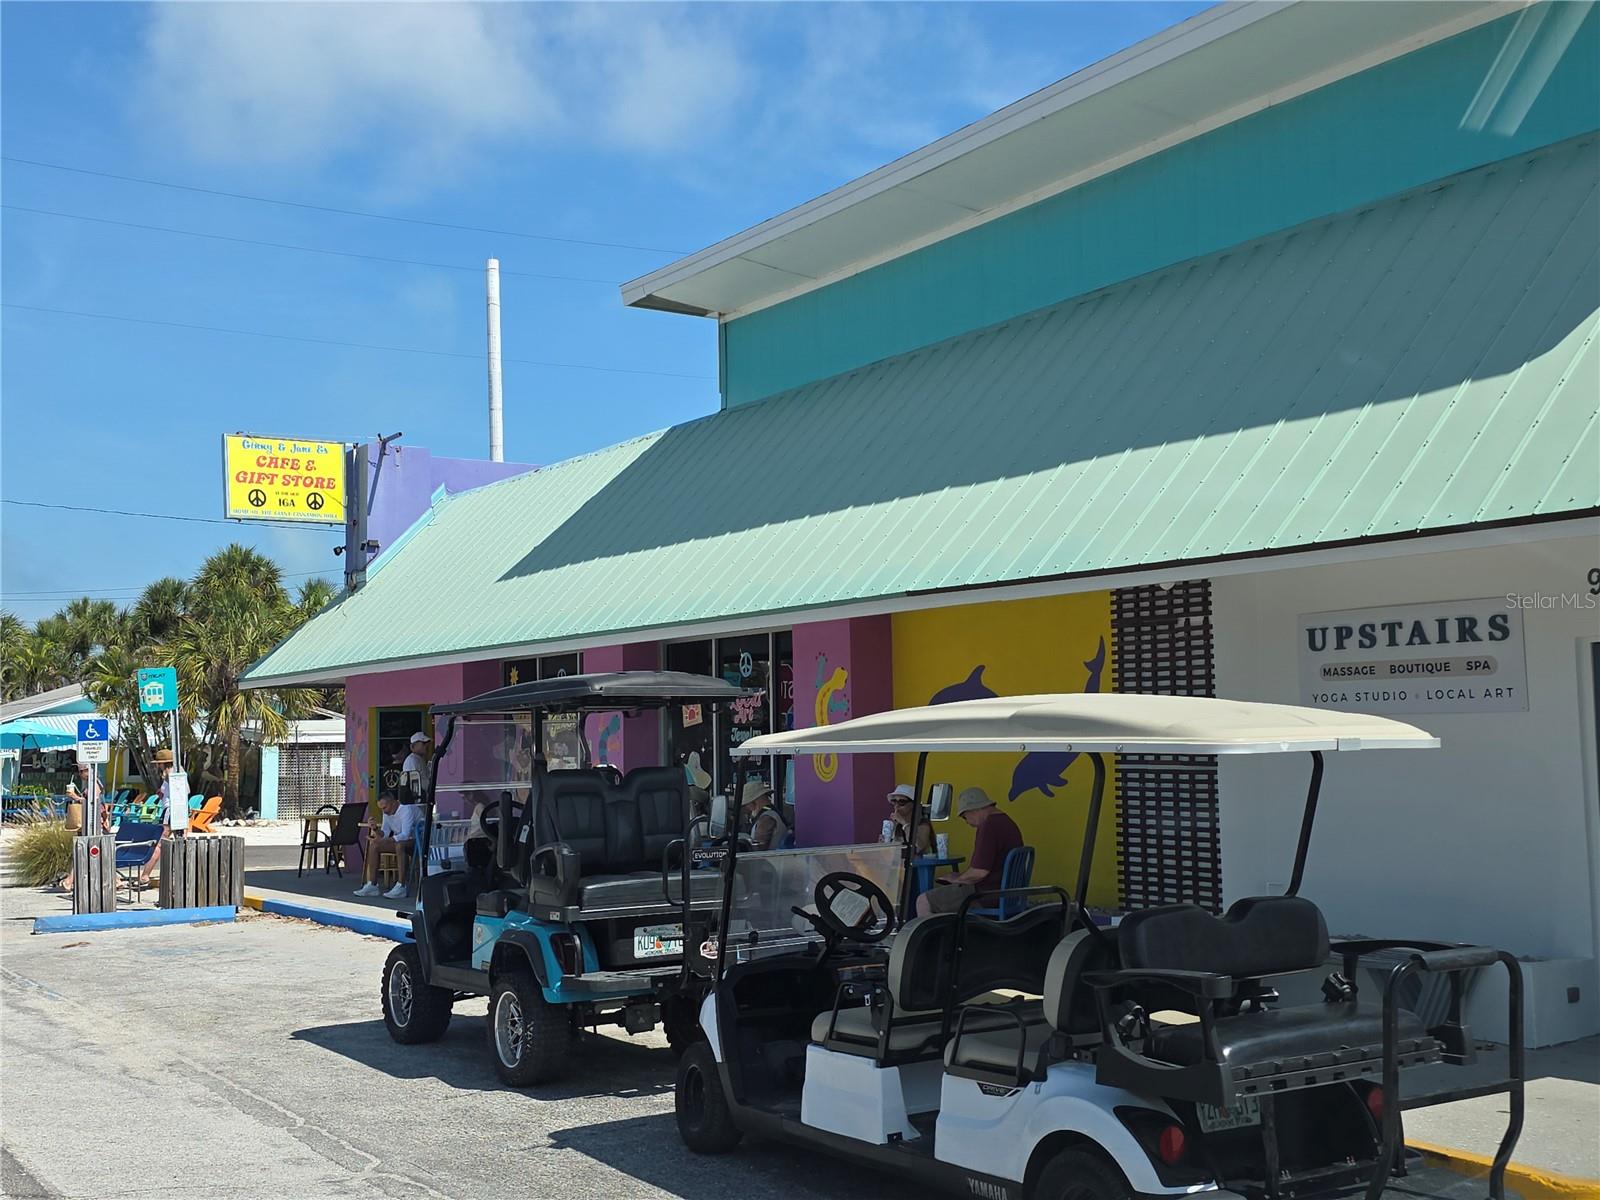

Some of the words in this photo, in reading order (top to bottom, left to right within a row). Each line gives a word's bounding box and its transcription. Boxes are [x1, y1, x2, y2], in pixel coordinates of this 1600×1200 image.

[278, 443, 286, 452] &
[256, 455, 301, 471] CAFE
[305, 460, 317, 471] &
[235, 470, 279, 486] GIFT
[281, 474, 336, 490] STORE
[278, 498, 296, 508] IGA
[1306, 614, 1510, 652] UPSTAIRS
[1323, 664, 1376, 677] MASSAGE
[1389, 661, 1451, 675] BOUTIQUE
[1465, 660, 1491, 671] SPA
[1312, 692, 1348, 703] YOGA
[1355, 690, 1408, 702] STUDIO
[1426, 688, 1475, 700] LOCAL
[1483, 687, 1514, 698] ART
[967, 1177, 1008, 1200] YAMAHA
